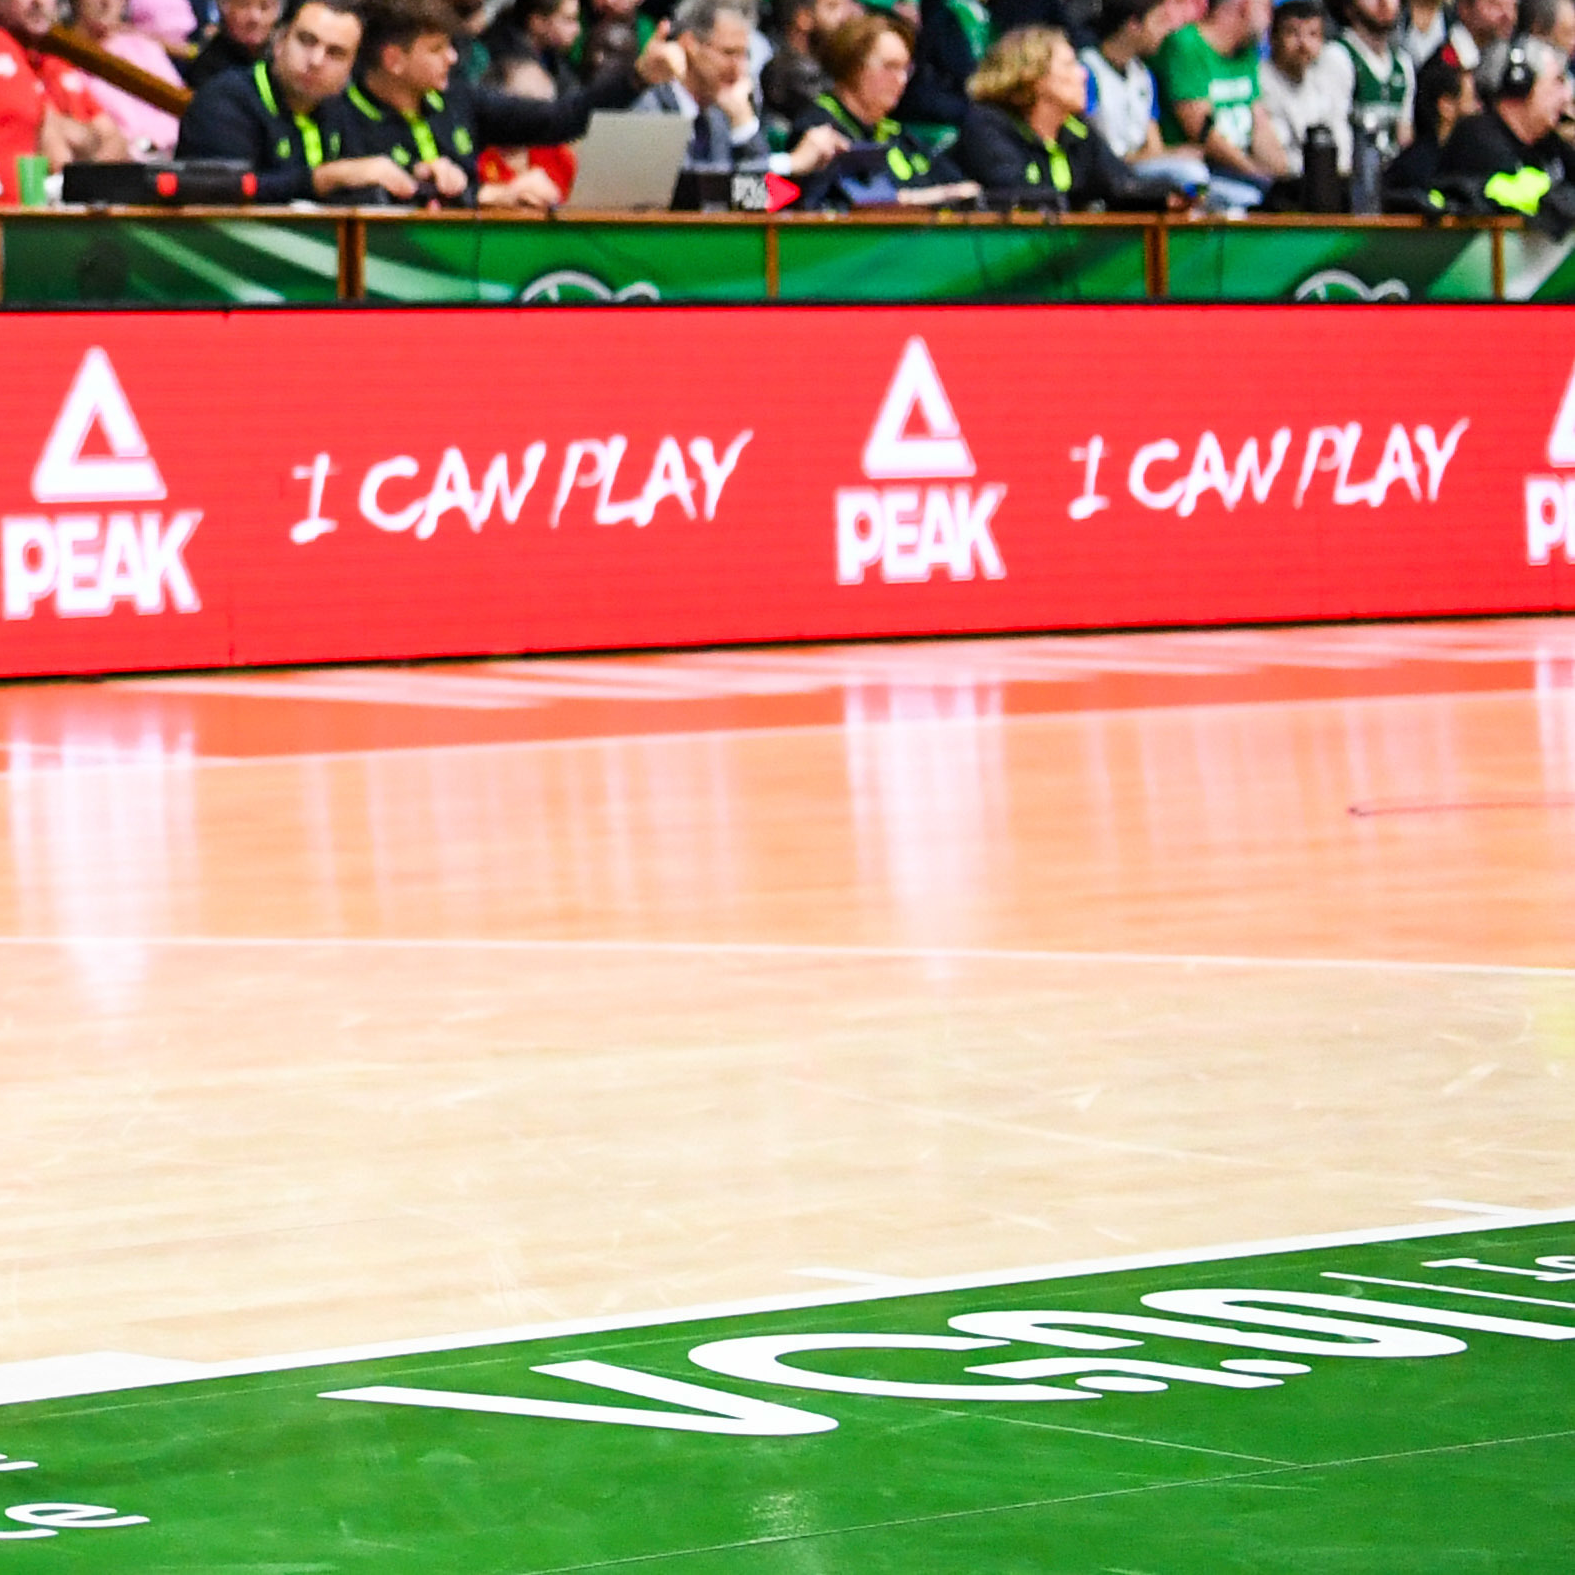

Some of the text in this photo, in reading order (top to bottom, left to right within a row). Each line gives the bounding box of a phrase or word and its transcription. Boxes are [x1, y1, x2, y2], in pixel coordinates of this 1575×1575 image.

[358, 440, 545, 540] CAN
[550, 428, 753, 529] PLAY
[1127, 427, 1292, 518] CAN
[1293, 418, 1471, 509] PLAY
[0, 508, 204, 622] PEAK
[834, 482, 1009, 587] PEAK
